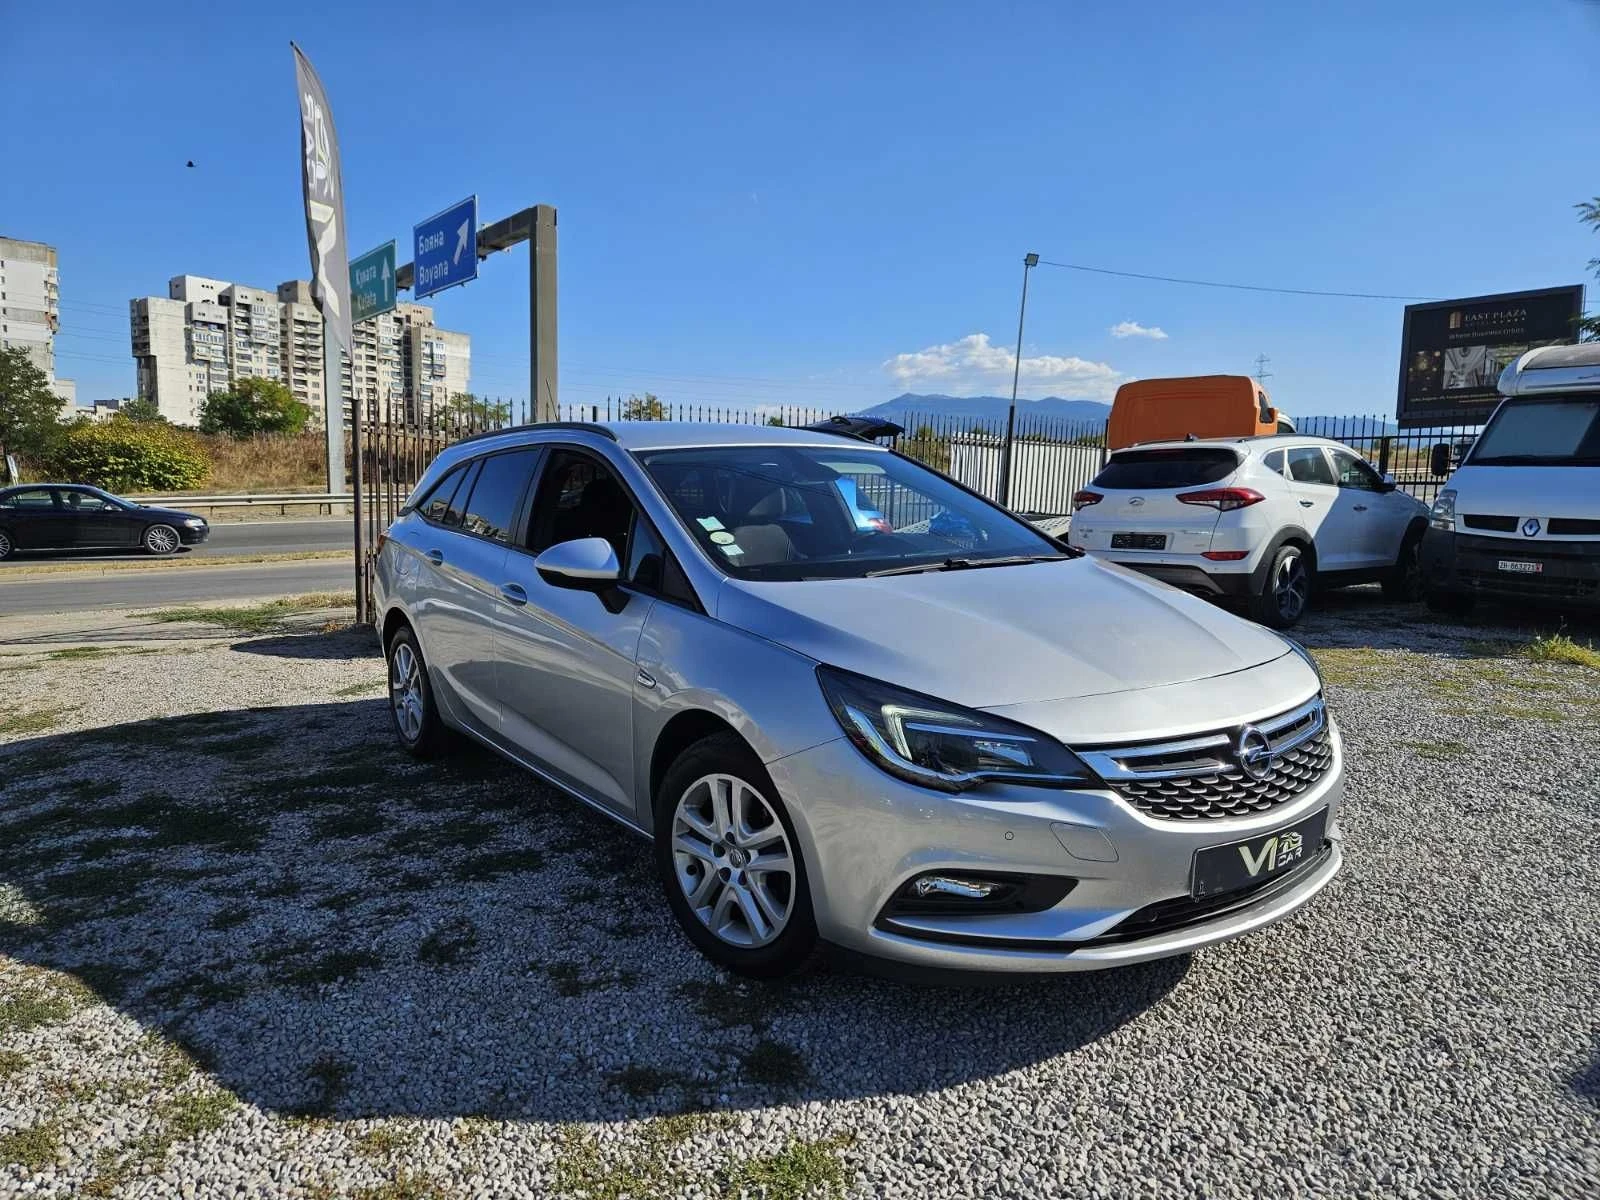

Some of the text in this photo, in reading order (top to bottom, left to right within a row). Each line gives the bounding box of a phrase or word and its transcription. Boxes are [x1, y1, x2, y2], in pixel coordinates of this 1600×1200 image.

[418, 231, 444, 256] Бояна
[420, 261, 448, 285] Boyana
[1493, 308, 1527, 319] PLAZA
[1278, 846, 1302, 867] CAR
